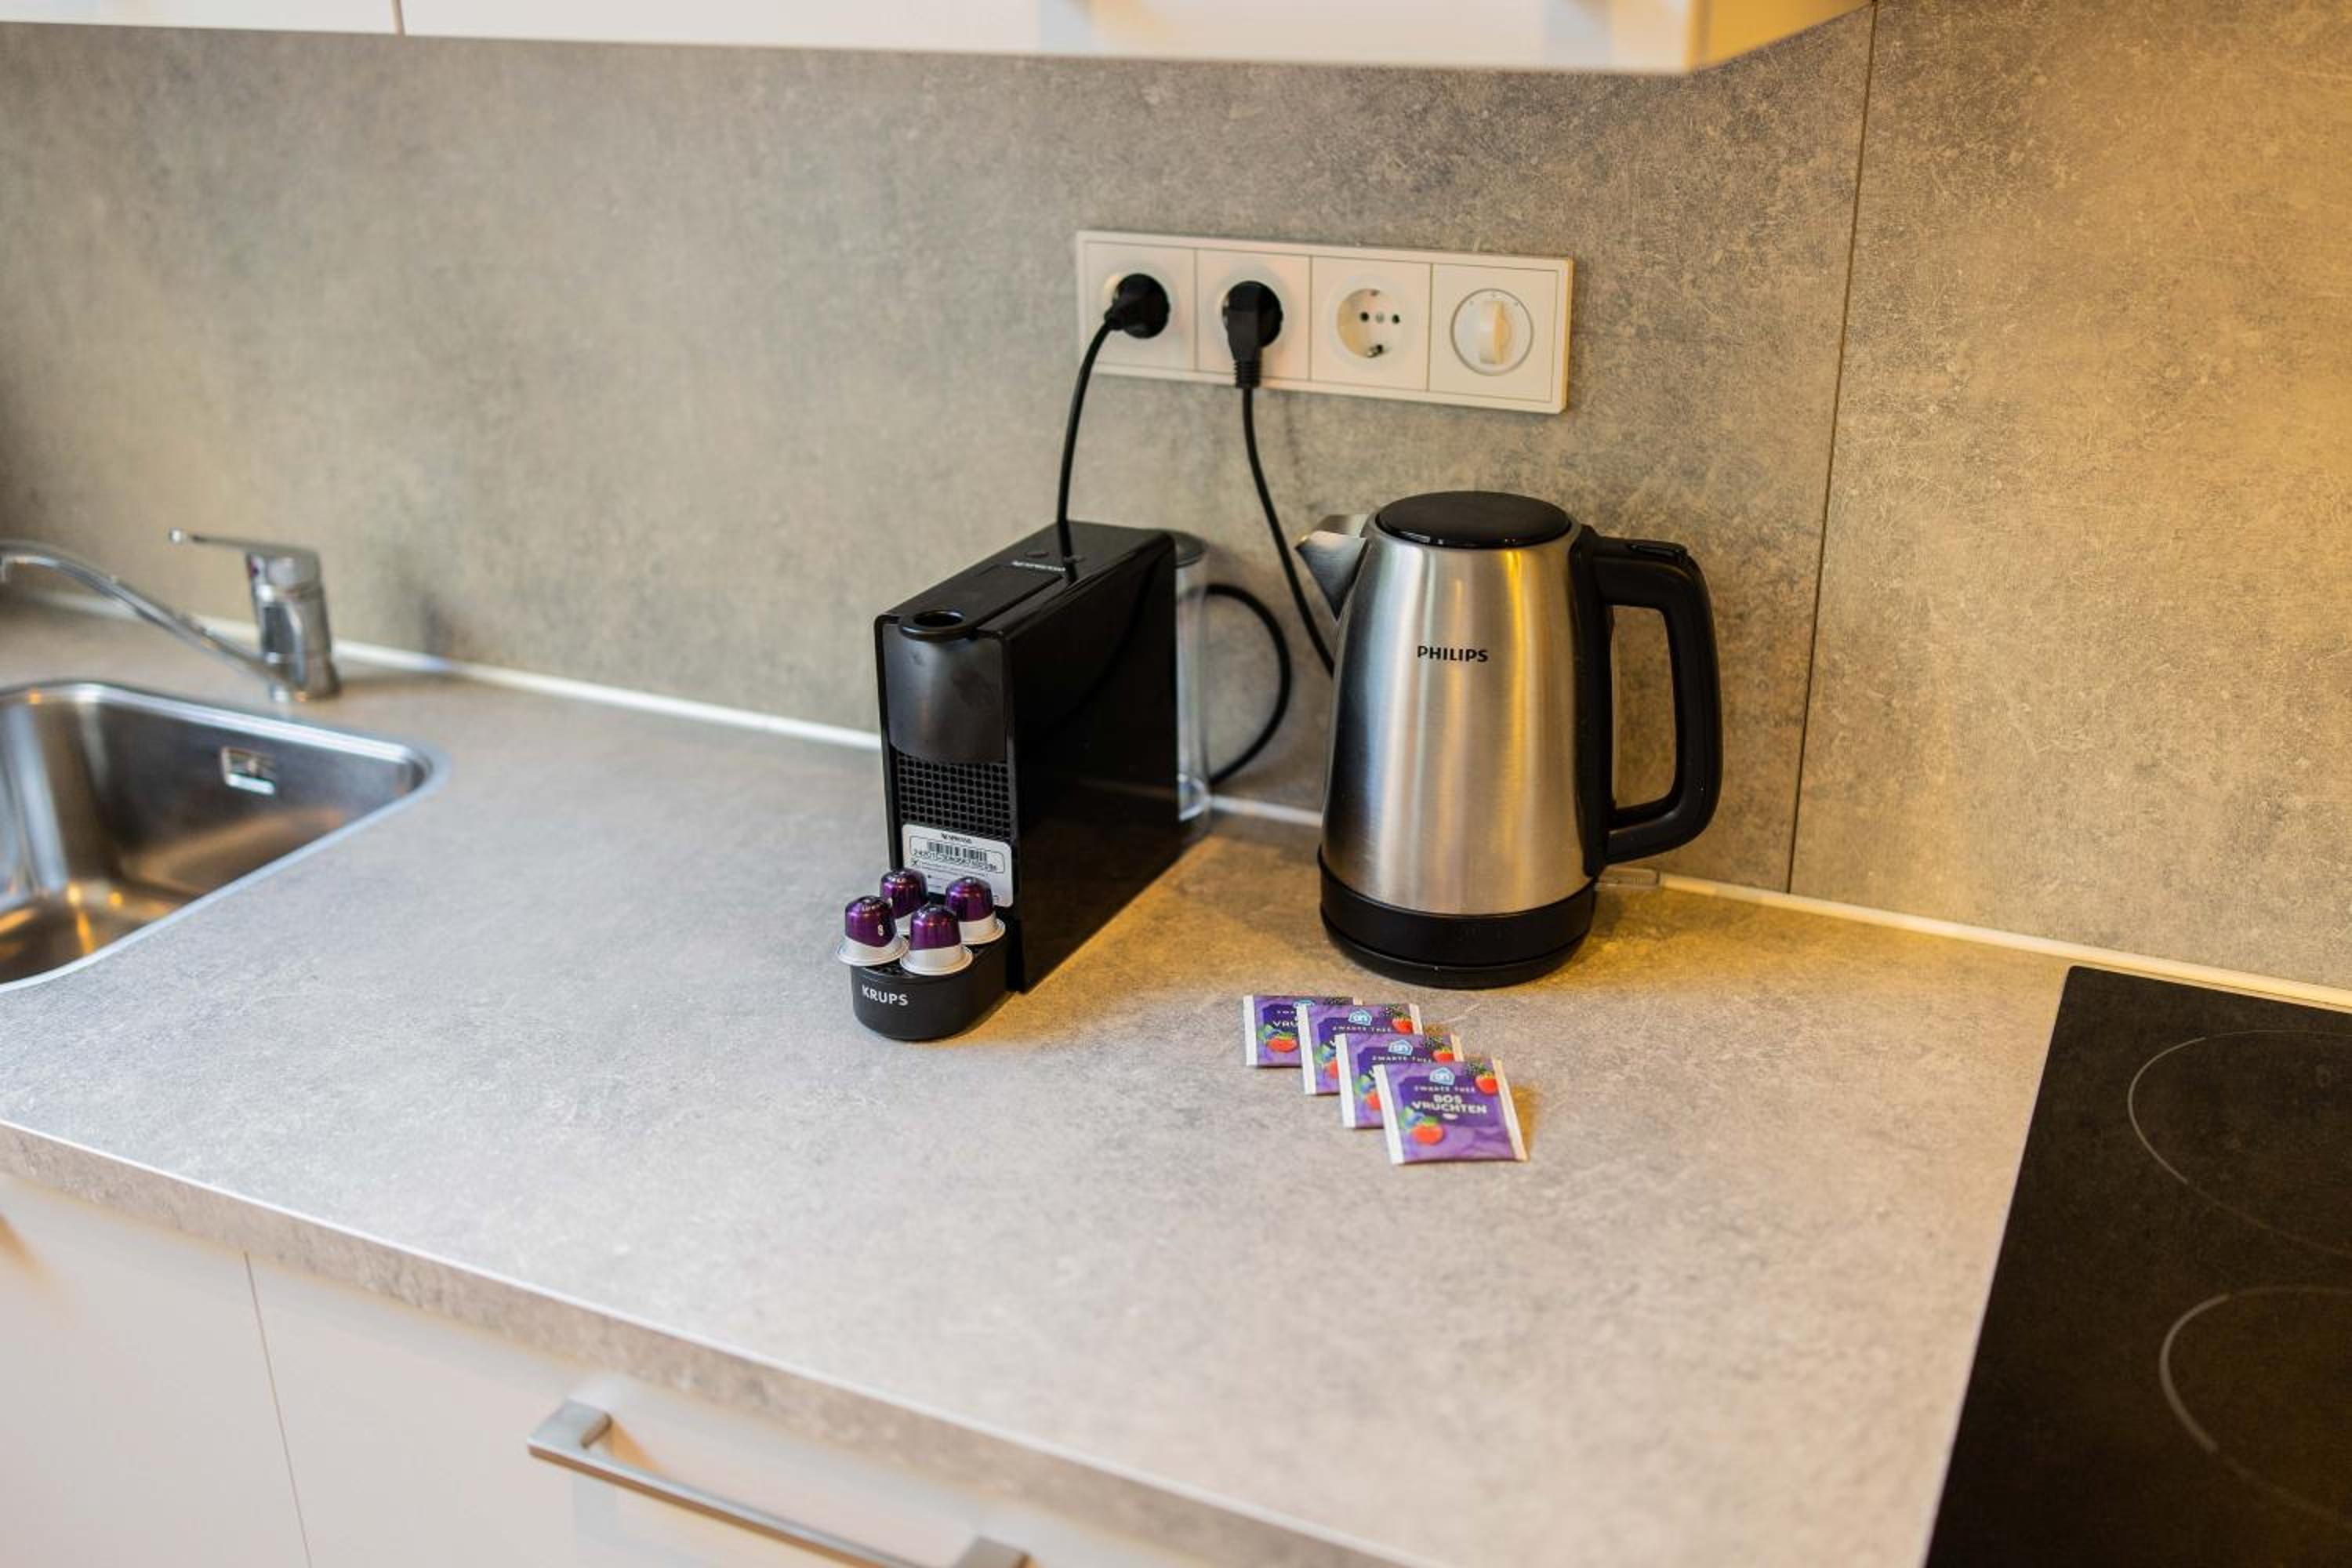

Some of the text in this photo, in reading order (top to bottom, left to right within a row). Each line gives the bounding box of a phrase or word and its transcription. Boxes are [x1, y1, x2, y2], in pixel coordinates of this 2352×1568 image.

[1417, 645, 1489, 662] PHILIPS
[862, 984, 909, 1006] KRUPS
[1433, 1094, 1462, 1105] BOS
[1411, 1101, 1487, 1114] VRUCHTEN
